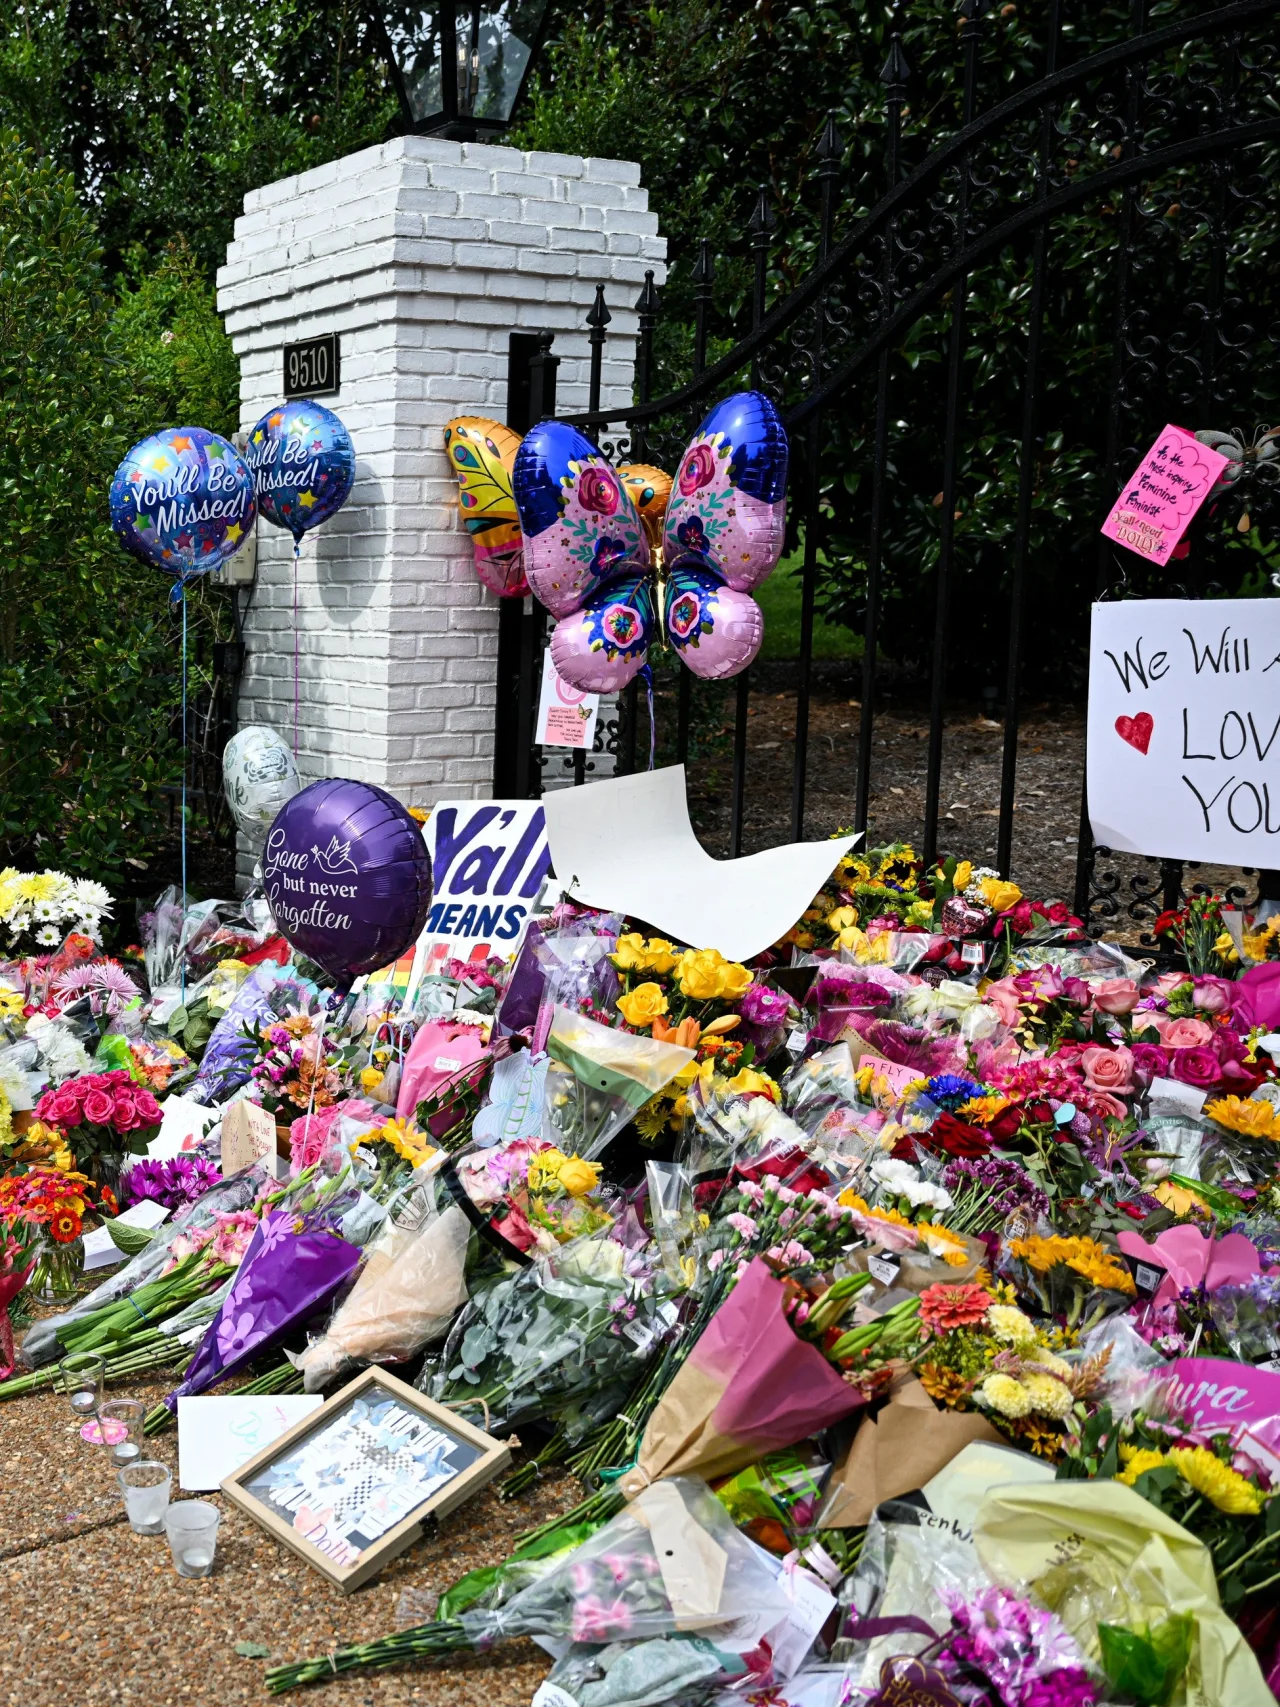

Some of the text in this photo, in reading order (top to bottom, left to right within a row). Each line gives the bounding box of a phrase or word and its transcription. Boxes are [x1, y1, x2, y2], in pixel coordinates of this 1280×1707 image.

[289, 346, 328, 389] 9510
[245, 439, 308, 470] ou'll Be
[1149, 460, 1166, 477] most
[1170, 453, 1185, 468] the
[131, 465, 237, 514] You'll Be
[156, 489, 248, 537] Missed!
[1139, 521, 1163, 539] need
[1104, 636, 1171, 694] We
[1182, 626, 1250, 674] Will
[264, 828, 309, 879] Gone
[283, 872, 358, 898] but never
[880, 1062, 904, 1078] FLY
